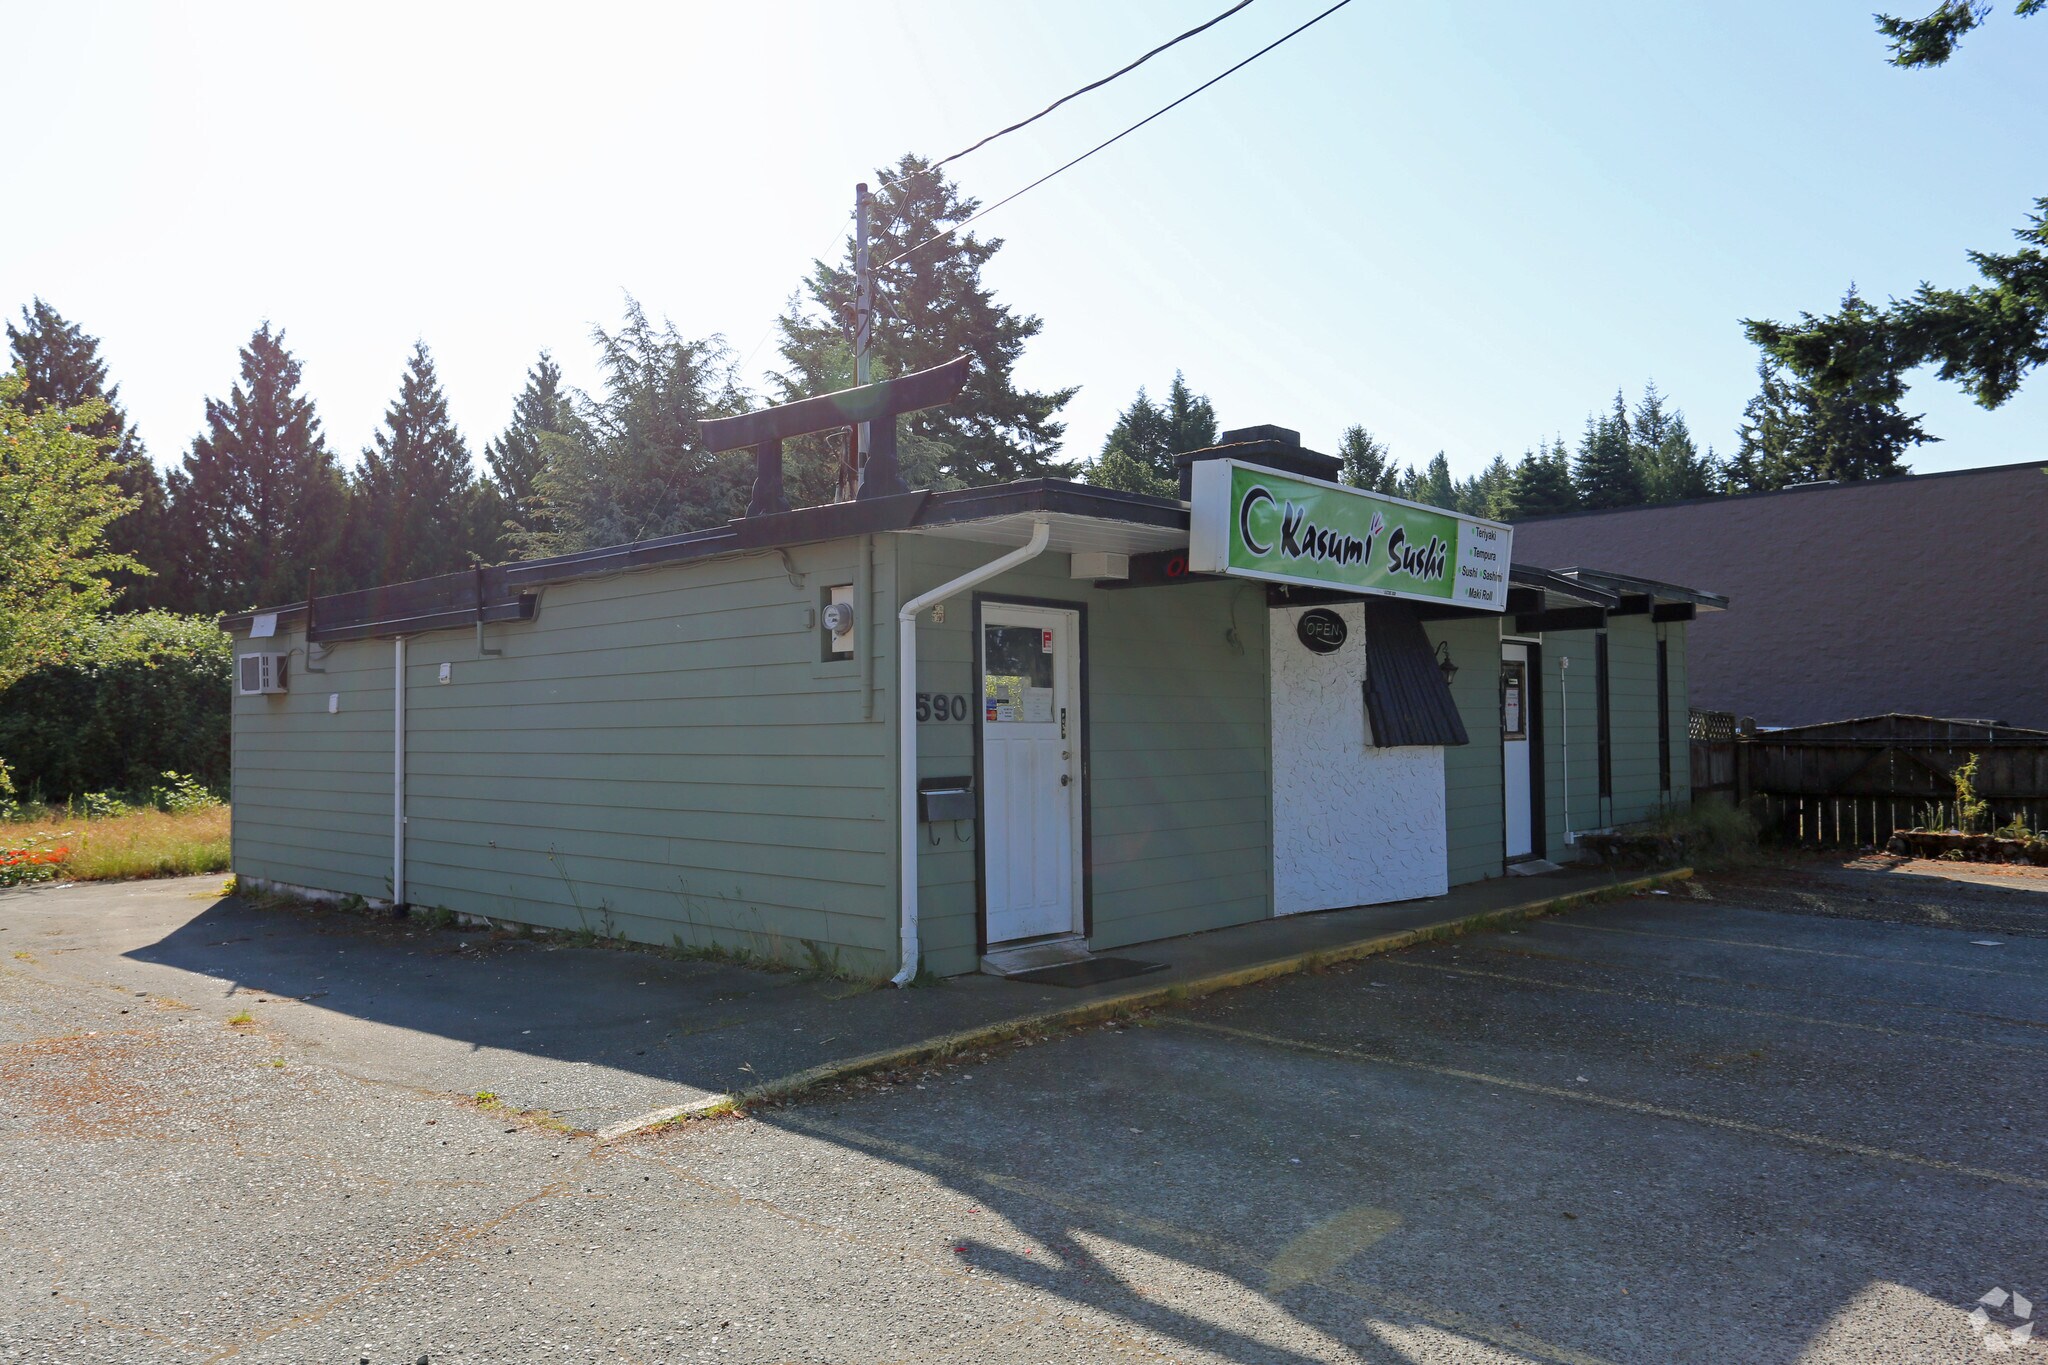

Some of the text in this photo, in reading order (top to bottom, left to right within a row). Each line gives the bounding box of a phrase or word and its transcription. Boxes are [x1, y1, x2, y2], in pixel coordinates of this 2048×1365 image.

[1281, 501, 1447, 581] Kasumi Sushi
[1475, 526, 1497, 542] Teriyaki
[1473, 546, 1497, 562] Tempura
[1461, 565, 1503, 583] Sushi Sashimi
[1468, 587, 1493, 601] Maki Roll
[1306, 622, 1340, 636] OPEN
